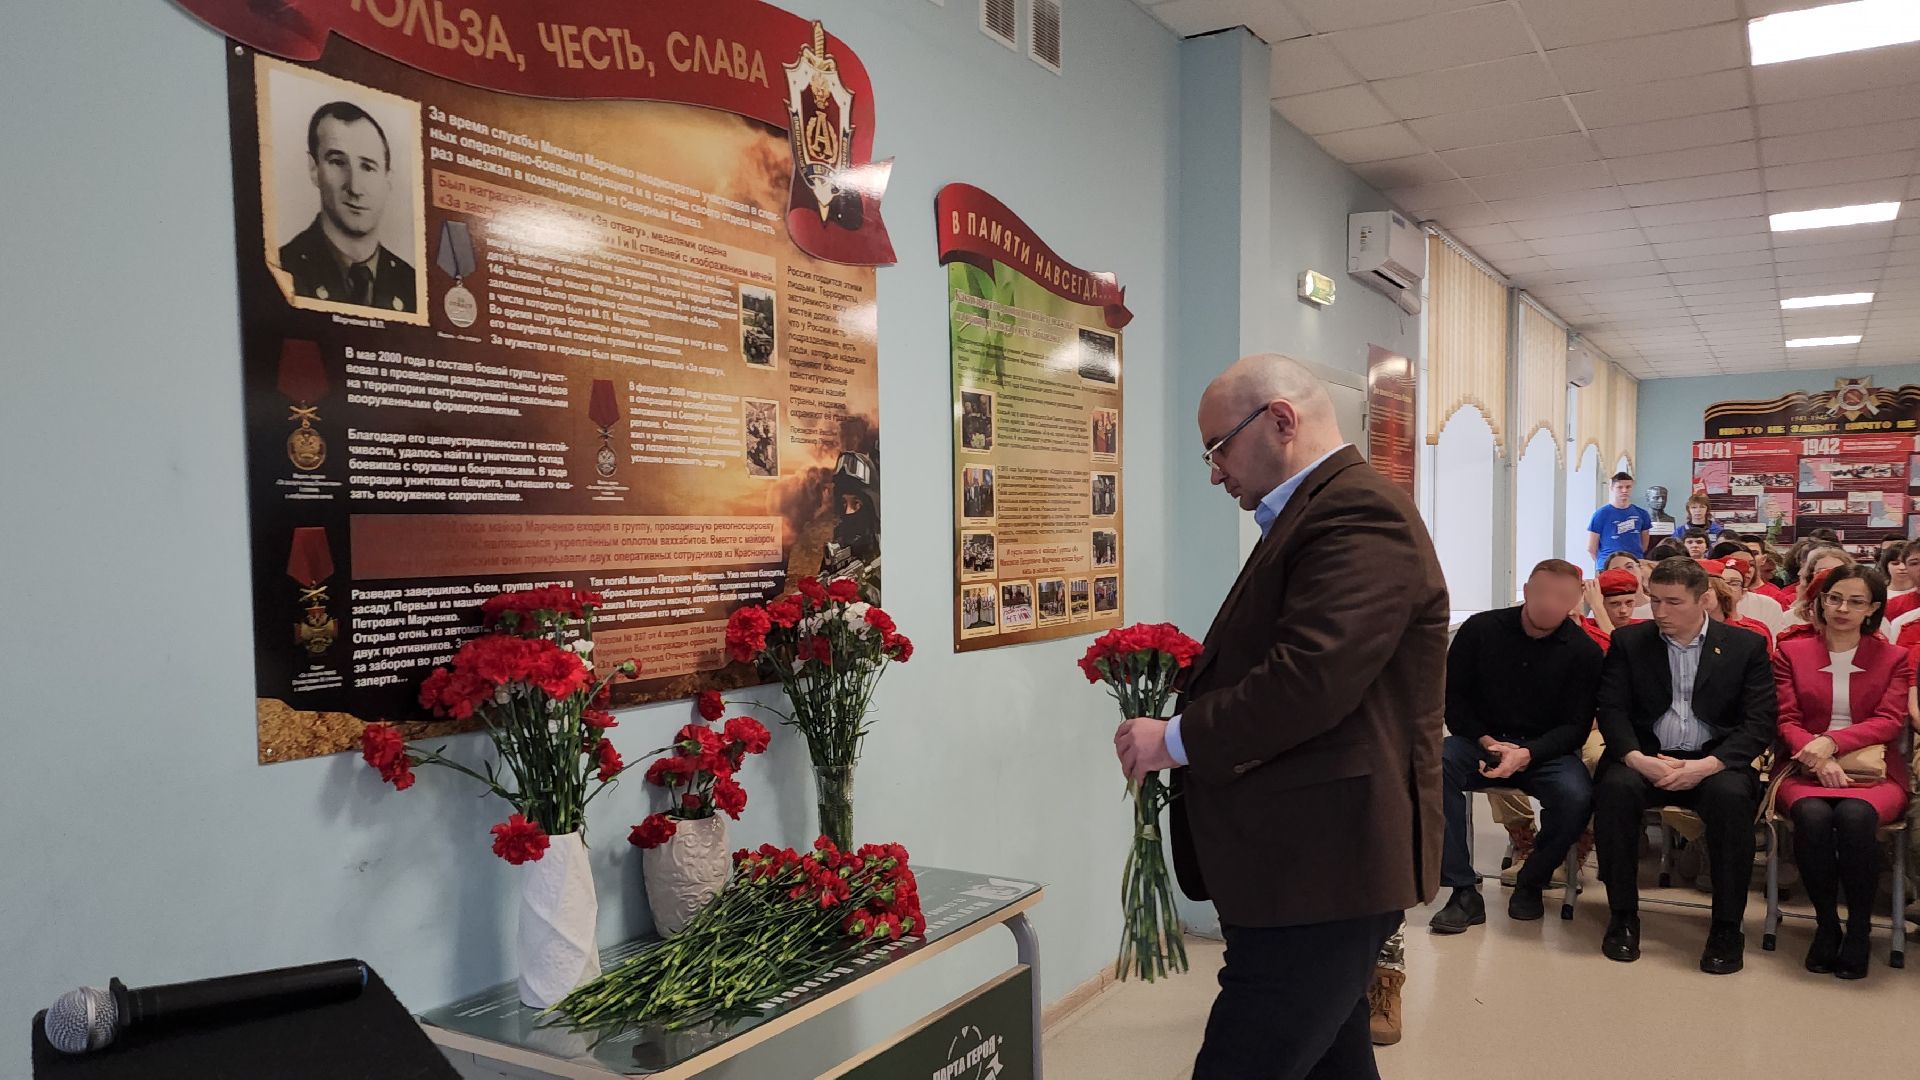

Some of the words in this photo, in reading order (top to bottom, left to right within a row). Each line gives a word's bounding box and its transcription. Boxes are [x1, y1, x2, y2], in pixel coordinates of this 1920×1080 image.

[351, 0, 526, 72] ОЛЬЗА,
[537, 22, 656, 77] ЧЕСТЬ,
[665, 31, 769, 88] СЛАВА
[429, 106, 446, 125] За
[448, 115, 490, 137] время
[490, 127, 539, 151] службы
[540, 139, 584, 164] Михаил
[584, 151, 635, 178] Марченко
[430, 127, 458, 145] ных
[459, 135, 578, 178] оперативно-боевых
[635, 184, 644, 196] и
[431, 147, 454, 162] раз
[456, 153, 512, 178] выезжал
[514, 167, 523, 181] в
[524, 170, 603, 201] командировки
[605, 192, 618, 205] на
[951, 210, 961, 235] В
[967, 212, 1031, 266] ПАМЯТИ
[345, 347, 355, 359] В
[356, 351, 376, 362] мае
[378, 350, 402, 365] 2000
[403, 356, 427, 368] года
[428, 359, 435, 368] в
[435, 360, 474, 372] составе
[474, 362, 509, 376] боевой
[510, 368, 542, 380] группы
[346, 364, 379, 377] вовал
[381, 368, 388, 378] в
[389, 368, 449, 384] проведении
[450, 374, 537, 393] разведывательных
[537, 381, 569, 397] рейдов
[346, 379, 361, 389] на
[362, 380, 426, 397] территории
[427, 386, 509, 403] контролируемой
[347, 395, 431, 409] вооруженными
[348, 429, 407, 446] Благодаря
[407, 435, 425, 445] его
[426, 436, 528, 450] целеустремленности
[528, 440, 535, 450] и
[1803, 437, 1841, 456] 1942
[348, 447, 397, 460] чивости,
[398, 449, 442, 461] удалось
[443, 449, 473, 461] найти
[474, 453, 482, 461] и
[482, 453, 537, 464] уничтожить
[537, 456, 565, 466] склад
[1698, 440, 1733, 460] 1941
[348, 459, 402, 473] боевиков
[402, 464, 411, 473] с
[411, 464, 458, 477] оружием
[458, 466, 466, 475] и
[466, 463, 538, 478] боеприпасами.
[539, 465, 547, 477] В
[547, 468, 568, 478] ходе
[349, 476, 402, 487] операции
[403, 478, 461, 488] уничтожил
[461, 477, 504, 490] бандита,
[349, 490, 376, 498] зать
[376, 490, 448, 501] вооруженное
[447, 491, 523, 502] сопротивление.
[613, 522, 620, 531] в
[621, 522, 652, 533] группу,
[654, 522, 712, 533] проводившую
[621, 538, 659, 547] оплотом
[660, 534, 708, 546] ваххабитов.
[710, 533, 738, 545] Вместе
[738, 535, 745, 544] с
[745, 531, 776, 545] майором
[589, 553, 612, 565] двух
[613, 552, 672, 564] оперативных
[673, 550, 723, 562] сотрудников
[723, 550, 733, 558] из
[590, 577, 604, 586] Так
[604, 575, 629, 586] погиб
[351, 589, 402, 600] Разведка
[403, 586, 473, 599] завершилась
[473, 583, 500, 595] боем,
[501, 582, 534, 595] группа
[351, 603, 393, 615] засаду.
[393, 600, 441, 614] Первым
[441, 600, 456, 610] из
[352, 617, 405, 631] Петрович
[406, 612, 461, 627] Марченко.
[352, 632, 396, 644] Открыв
[398, 629, 429, 640] огонь
[430, 628, 443, 638] из
[353, 646, 381, 658] двух
[382, 640, 454, 657] противников.
[353, 663, 366, 673] за
[368, 658, 416, 672] забором
[417, 656, 431, 668] во
[966, 1033, 996, 1070] ГЕРОЯ
